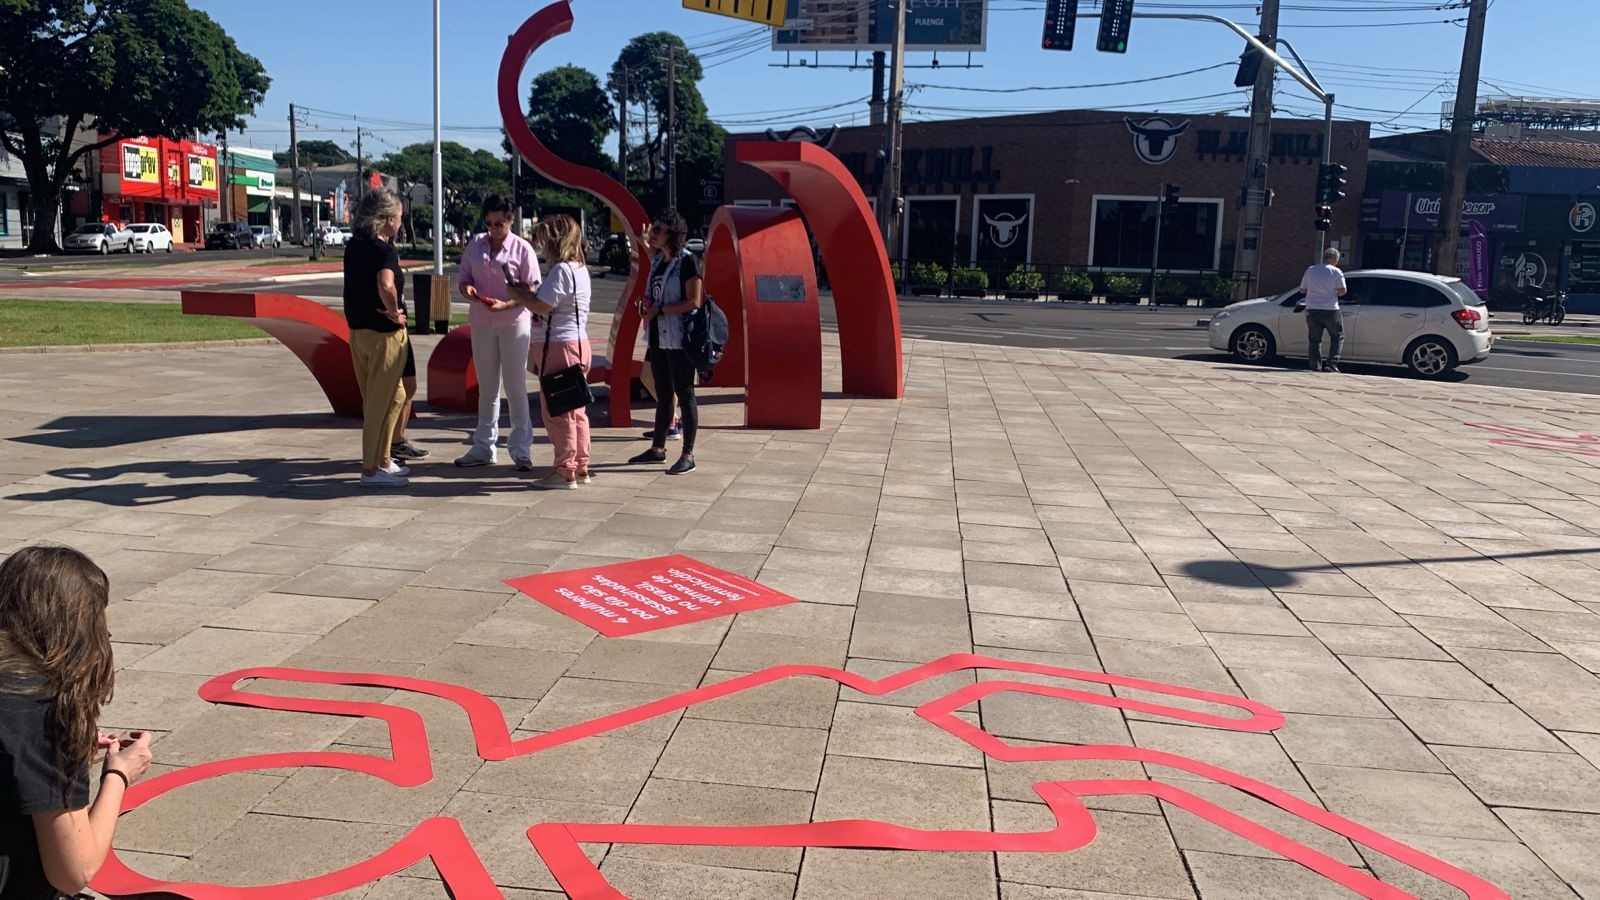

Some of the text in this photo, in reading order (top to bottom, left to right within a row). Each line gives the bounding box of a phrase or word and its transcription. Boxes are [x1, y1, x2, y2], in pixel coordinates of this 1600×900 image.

[652, 575, 672, 584] de
[554, 587, 620, 618] mulheres
[581, 585, 659, 620] por dia são
[678, 601, 702, 611] no
